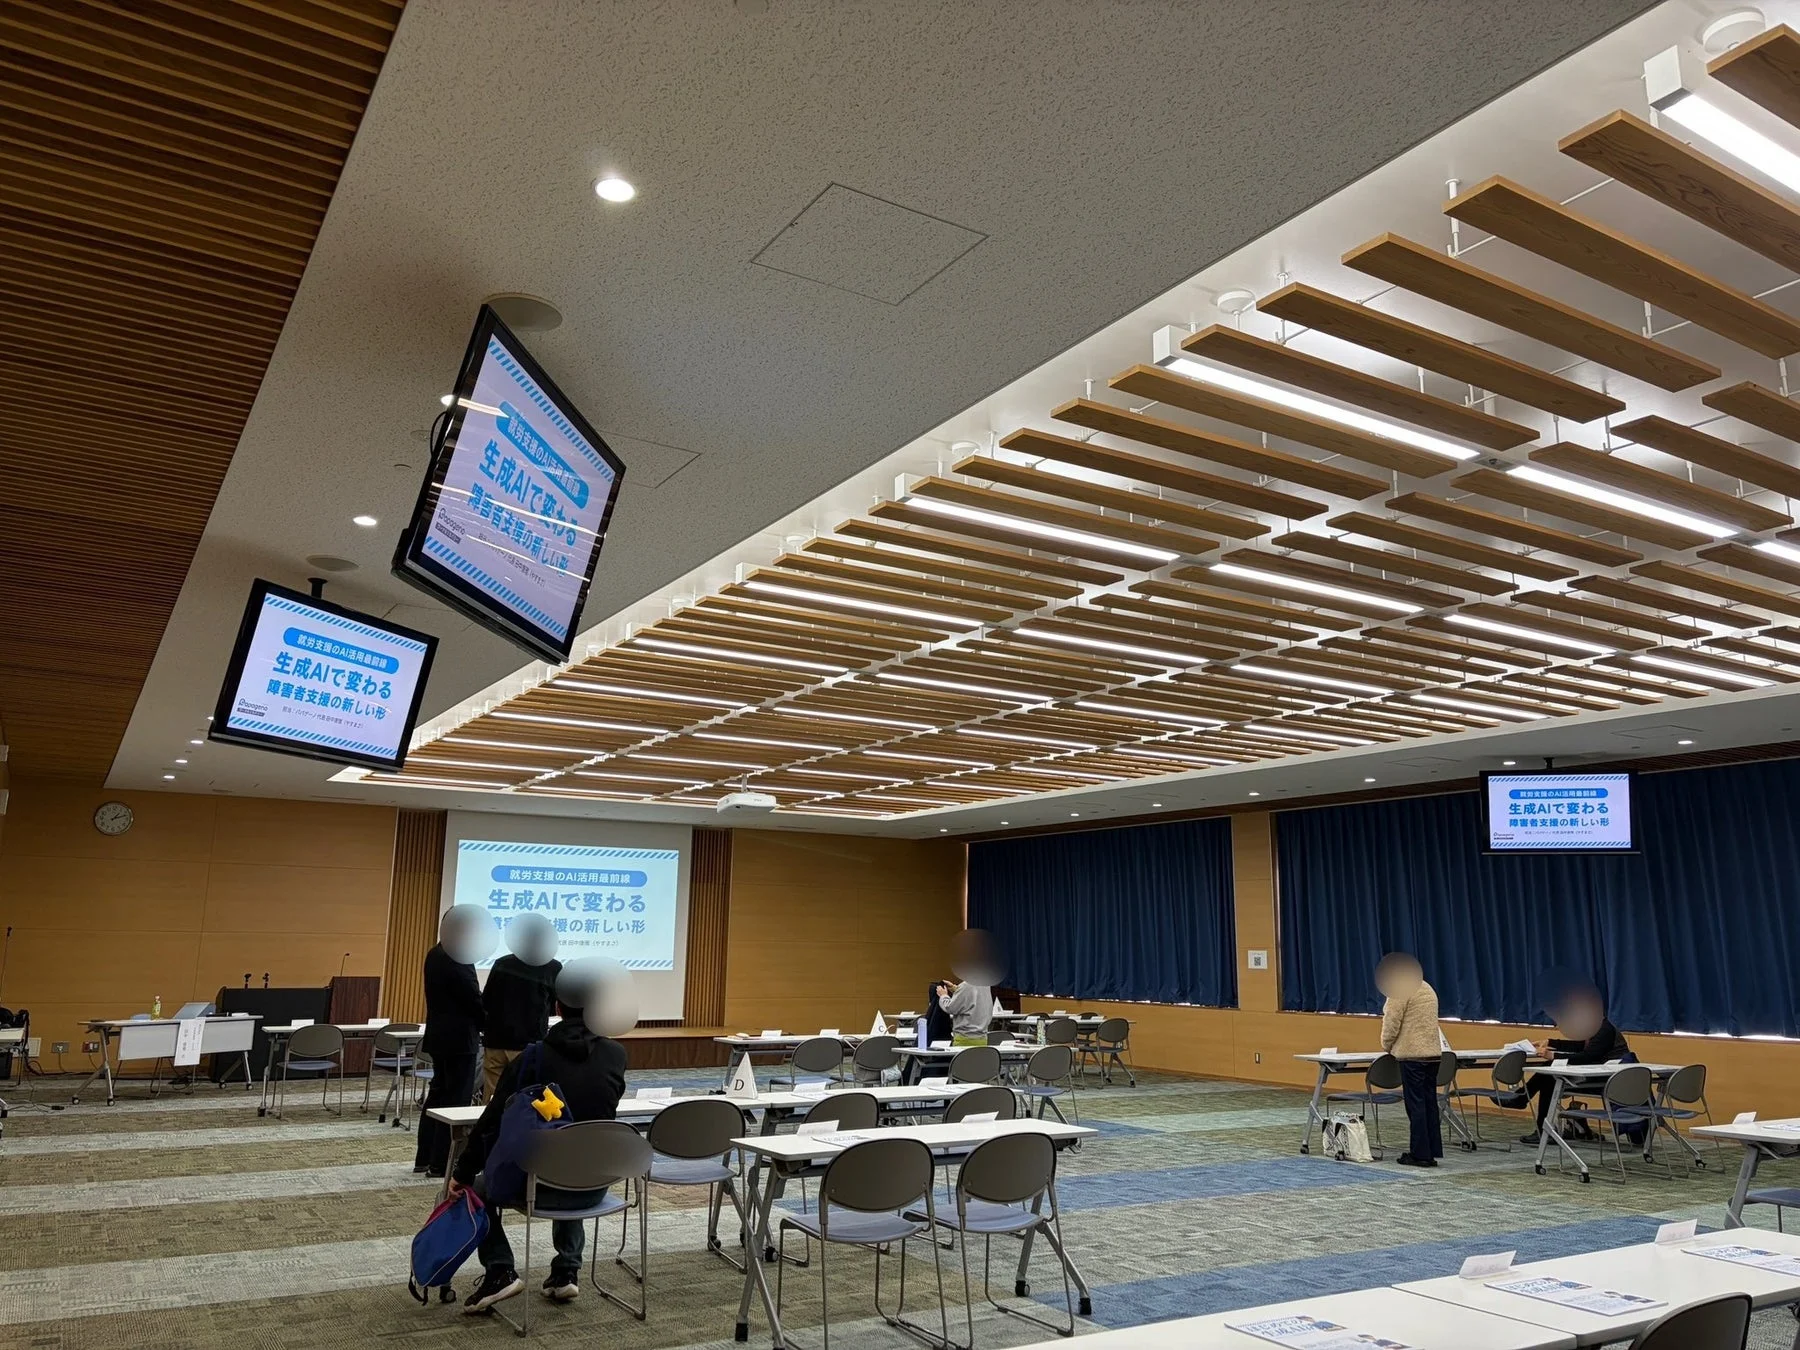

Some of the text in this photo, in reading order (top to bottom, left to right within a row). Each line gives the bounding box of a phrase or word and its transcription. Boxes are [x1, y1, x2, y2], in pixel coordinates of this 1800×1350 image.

[479, 440, 578, 546] 生成AIで変わる
[468, 483, 568, 577] 障害者支援の新しい形
[297, 634, 387, 668] 就労支援のAI活用最前線
[273, 652, 393, 700] 生成AIで変わる
[267, 679, 386, 720] 障害者支援の新しい形
[1509, 802, 1608, 815] 生成AIで変わる
[1509, 818, 1609, 827] 障害者支援の新しい形
[510, 870, 631, 884] 就労支援のAI活用最前線
[488, 889, 646, 913] 生成AIで変わる
[734, 1079, 745, 1091] D
